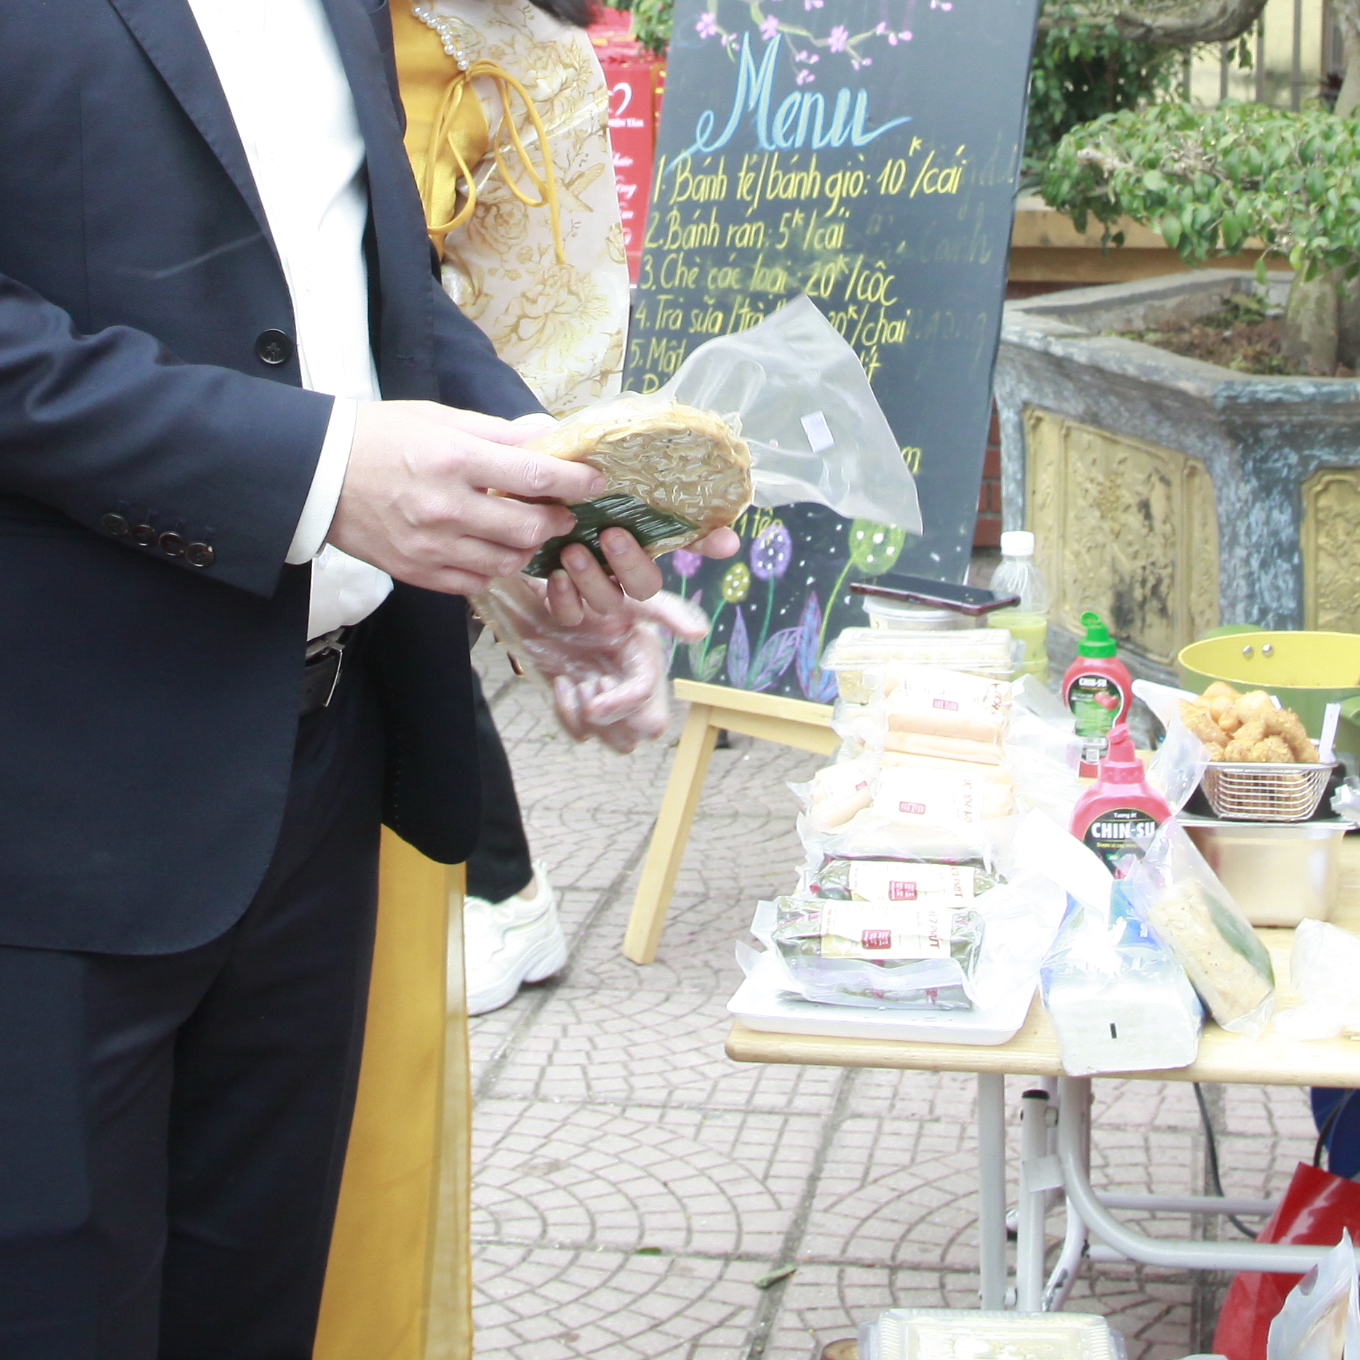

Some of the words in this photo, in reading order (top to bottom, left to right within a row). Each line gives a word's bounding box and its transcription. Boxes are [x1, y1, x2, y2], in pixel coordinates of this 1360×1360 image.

[668, 31, 911, 170] Menu
[668, 154, 728, 206] Bánh
[663, 204, 721, 250] Bánh
[660, 251, 701, 291] Chè
[1091, 821, 1156, 839] CHIN-SU
